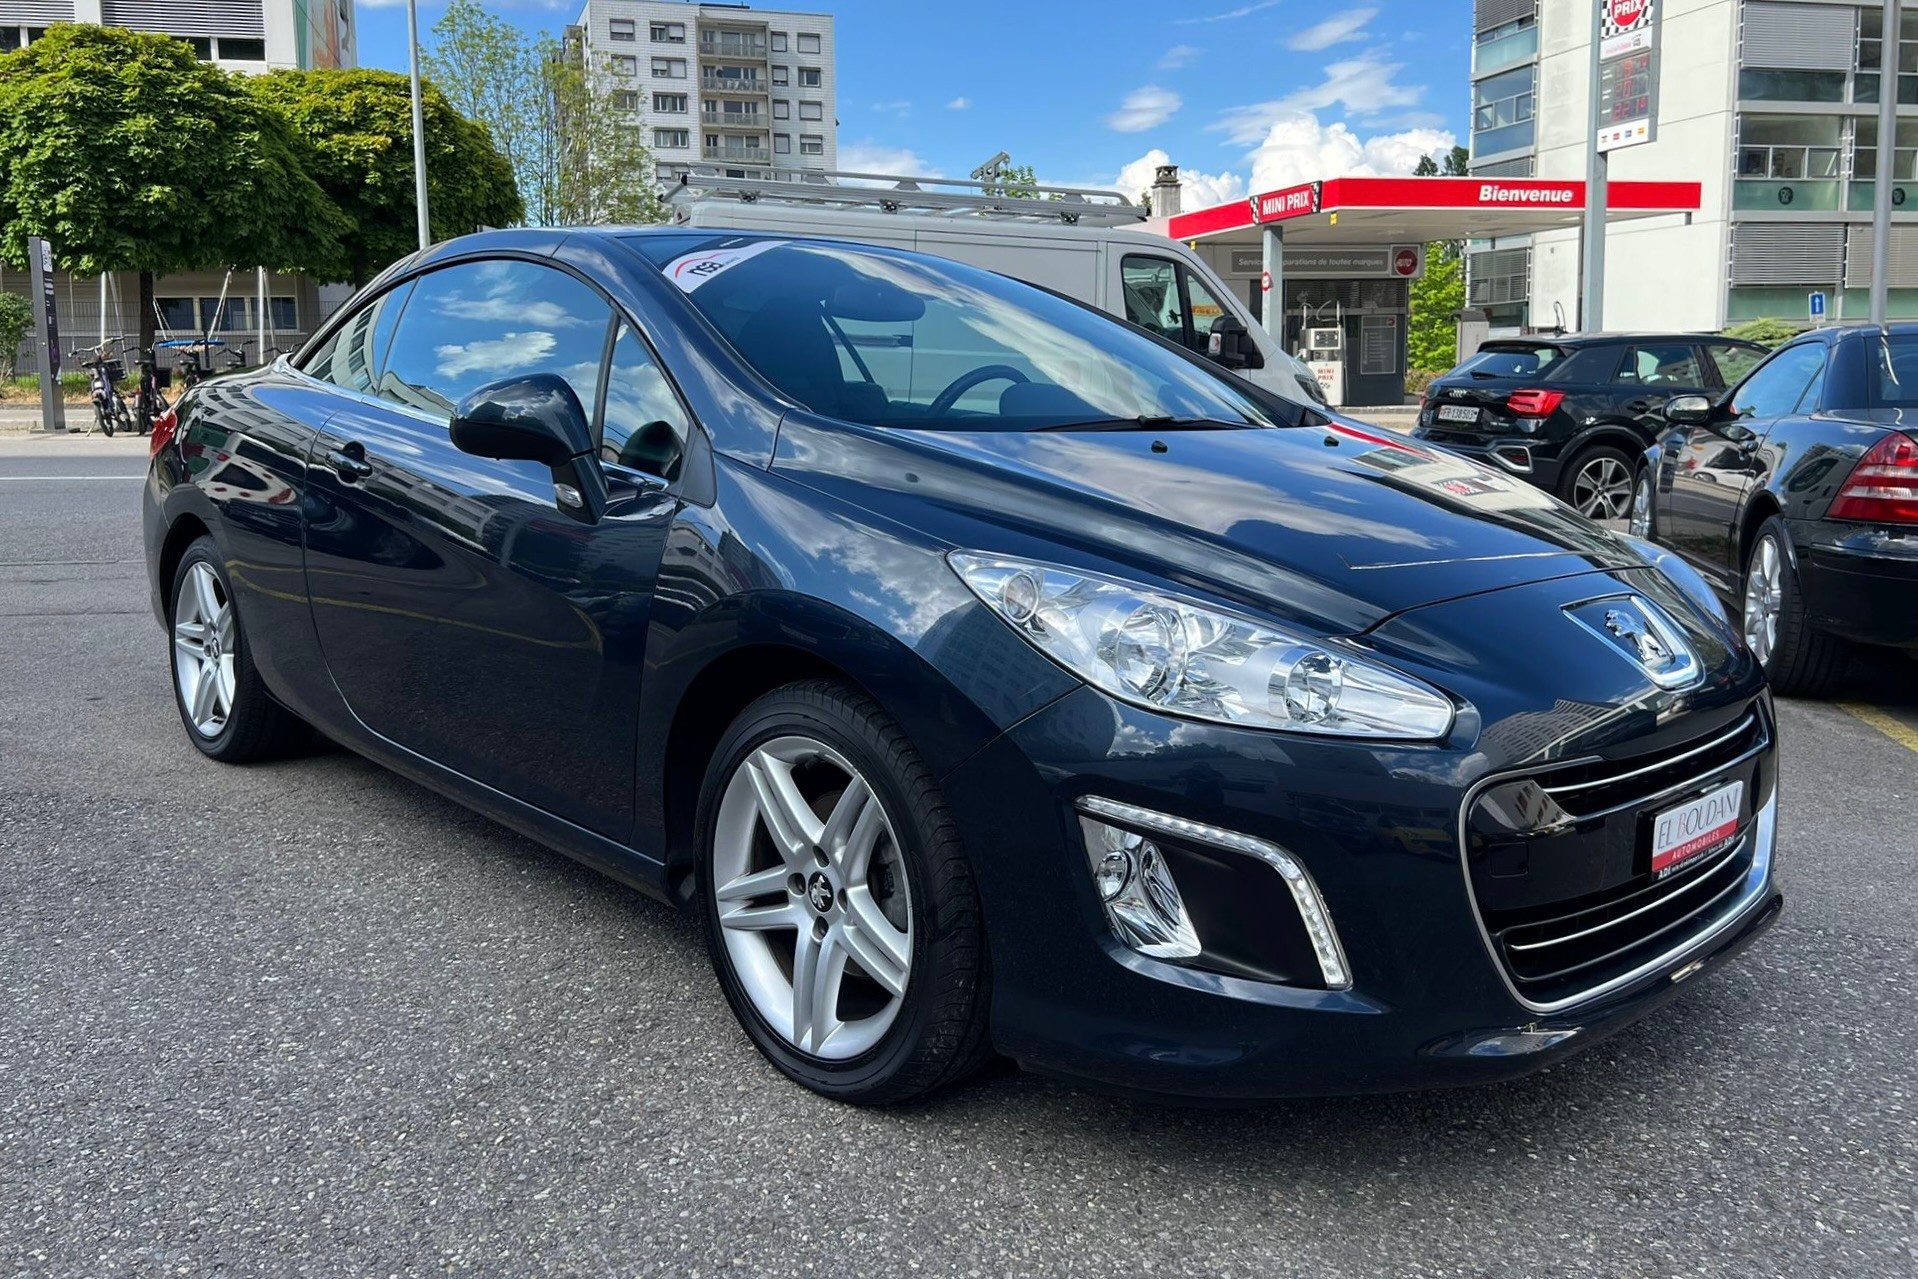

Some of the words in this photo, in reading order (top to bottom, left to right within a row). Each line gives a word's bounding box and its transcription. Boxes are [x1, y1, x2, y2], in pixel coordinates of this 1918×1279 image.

[1613, 0, 1642, 19] PRIX
[1262, 196, 1285, 216] MINI
[1286, 190, 1310, 211] PRIX
[1478, 184, 1573, 203] Bienvenue
[1657, 819, 1673, 850] EL
[1671, 830, 1720, 860] AUTOMOBILES
